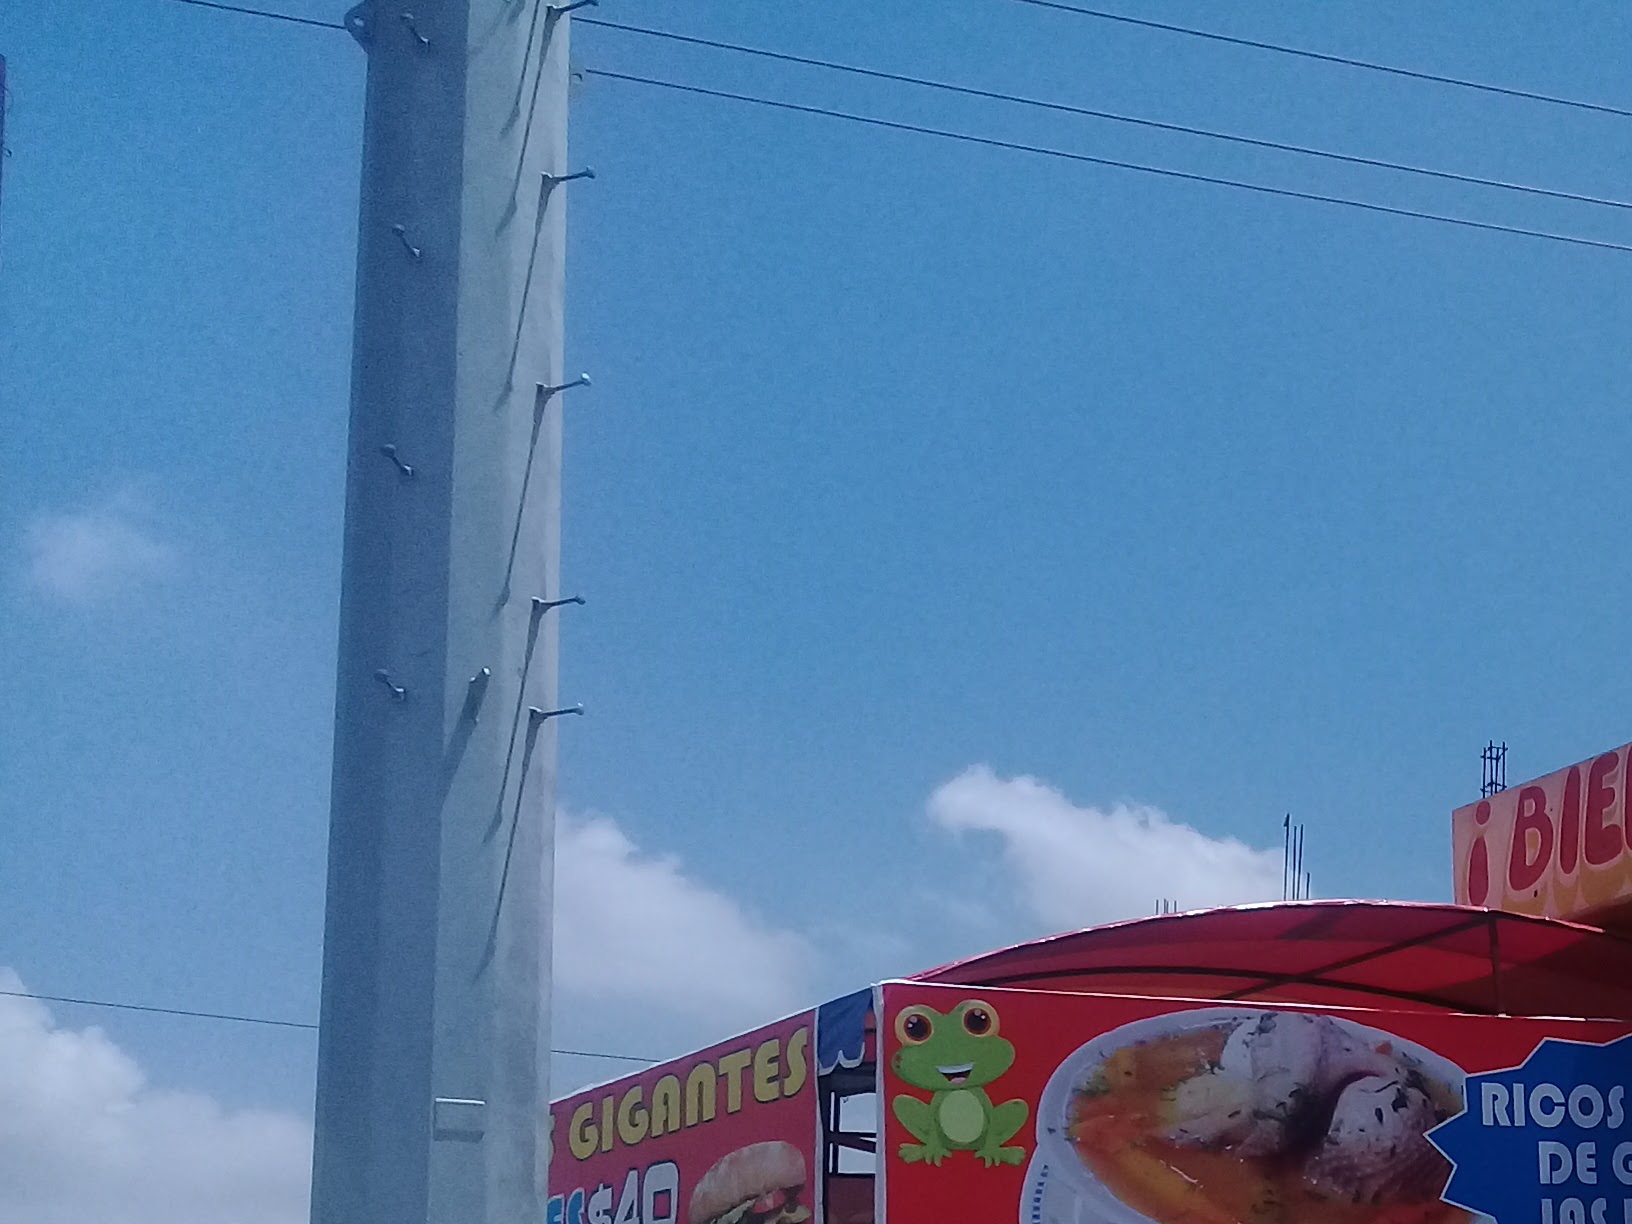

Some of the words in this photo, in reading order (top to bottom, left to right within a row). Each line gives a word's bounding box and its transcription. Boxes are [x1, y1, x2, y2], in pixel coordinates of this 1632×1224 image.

[568, 1024, 810, 1161] GIGANTES
[1480, 1082, 1626, 1130] RICOS
[1538, 1140, 1611, 1185] DE
